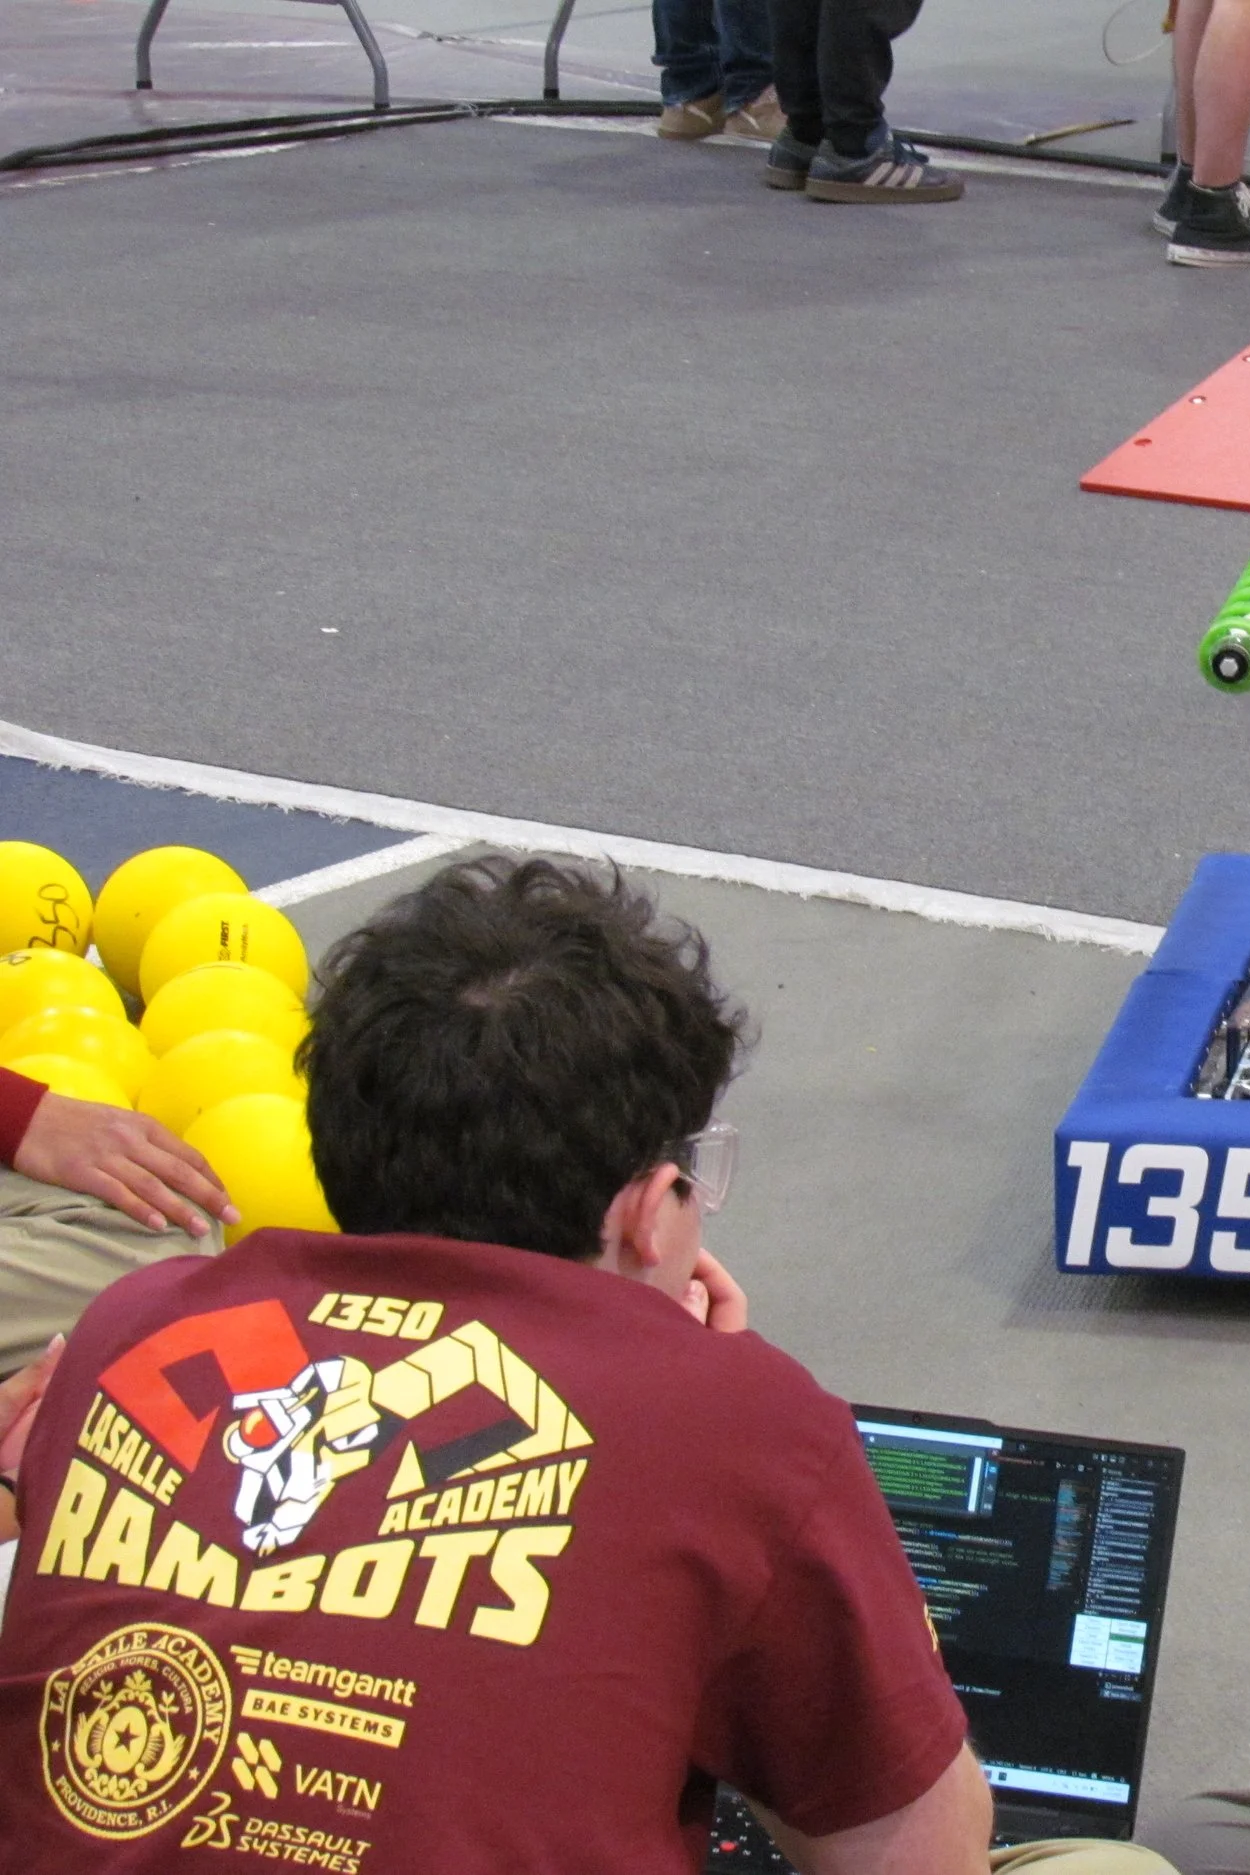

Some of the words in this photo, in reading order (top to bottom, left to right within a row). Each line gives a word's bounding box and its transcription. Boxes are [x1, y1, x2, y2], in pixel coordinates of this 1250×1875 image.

[307, 1293, 445, 1341] 1350
[77, 1391, 183, 1506] LASALLE
[377, 1458, 588, 1536] ACADEMY
[36, 1456, 573, 1647] RAMBOTS
[152, 1634, 224, 1745] ACADEMY
[262, 1652, 416, 1707] teamgantt
[251, 1697, 290, 1717] BAE
[298, 1705, 394, 1739] SYSTEMS
[146, 1799, 173, 1822] R.I.
[295, 1763, 382, 1811] VATN
[336, 1803, 372, 1820] Systems
[236, 1835, 361, 1875] SYSTEMES
[244, 1817, 371, 1857] DASSAULT
